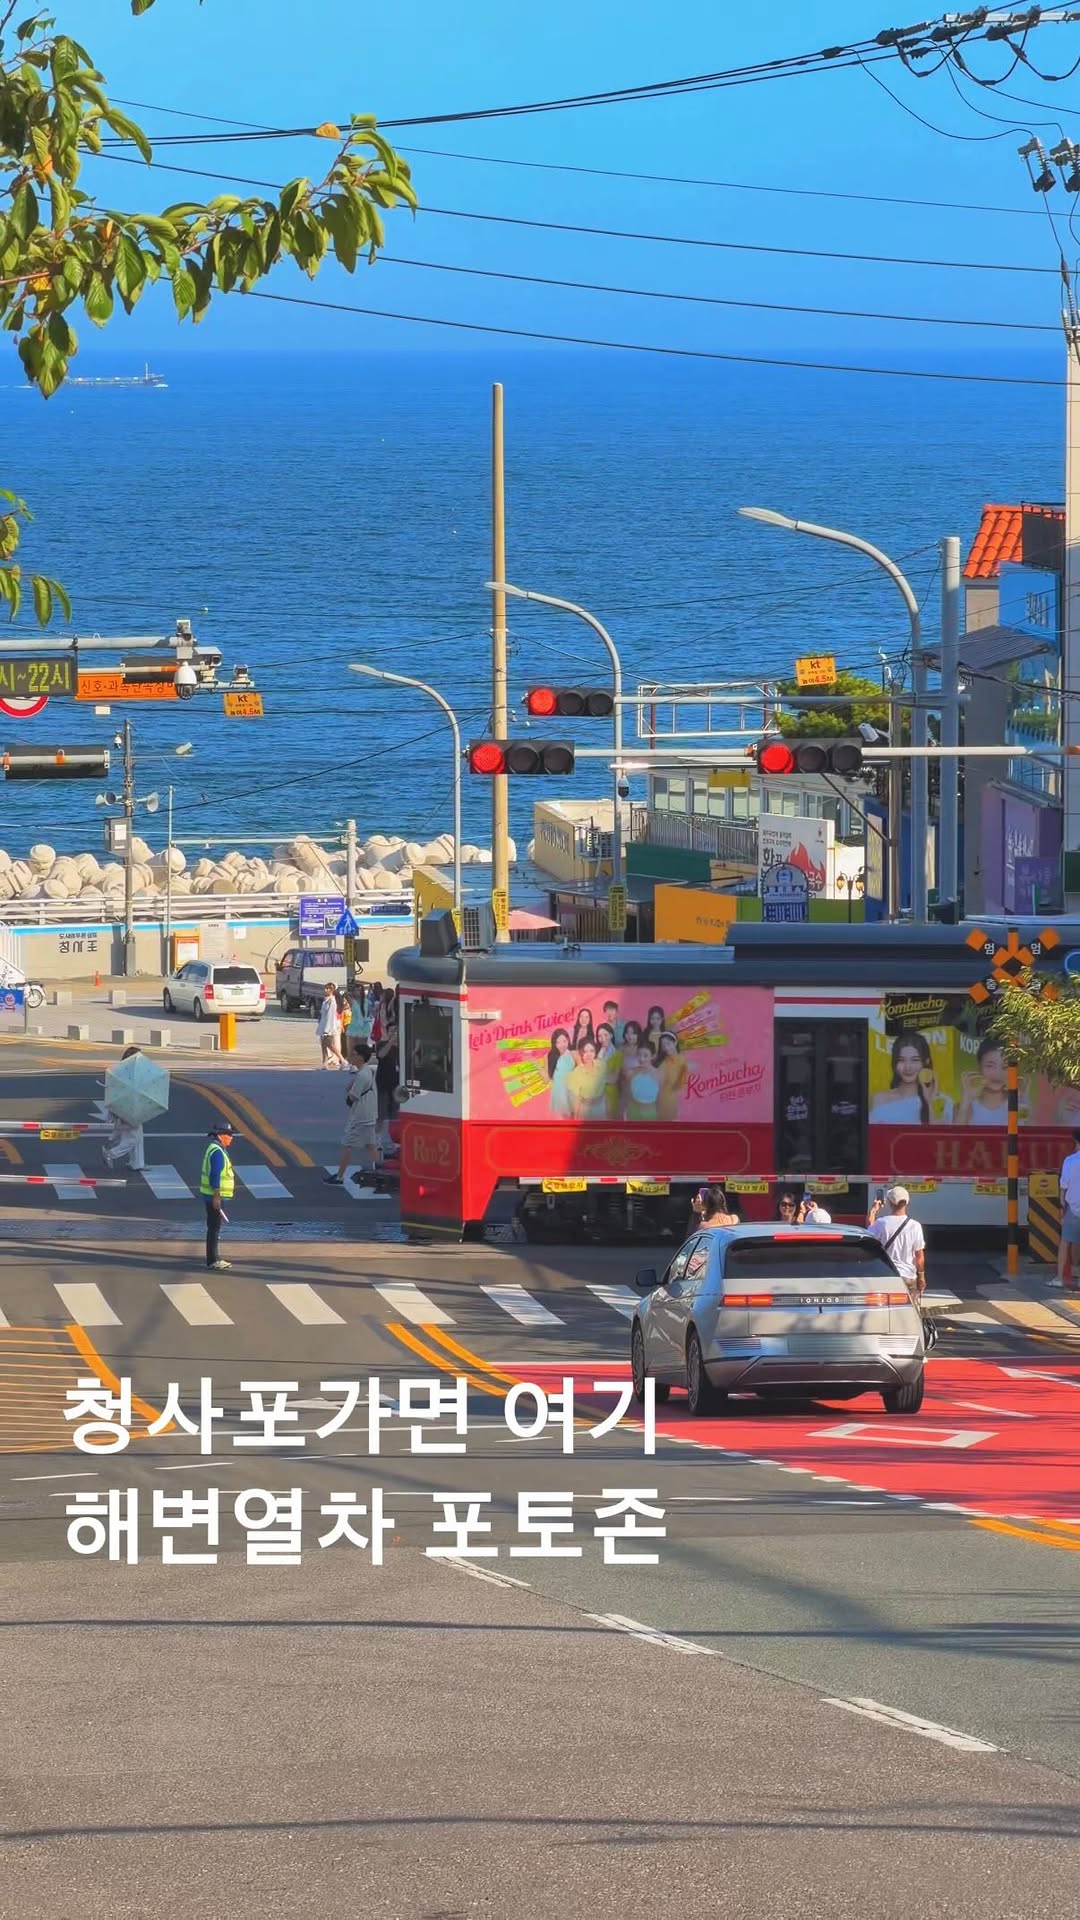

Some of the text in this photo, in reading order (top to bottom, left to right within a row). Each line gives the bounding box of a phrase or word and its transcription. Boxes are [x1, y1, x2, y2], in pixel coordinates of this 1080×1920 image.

[810, 660, 821, 669] kt
[878, 995, 948, 1021] Kombucha
[492, 1022, 533, 1041] Drink
[533, 1007, 577, 1032] Twice!
[685, 1062, 766, 1100] Kombucha
